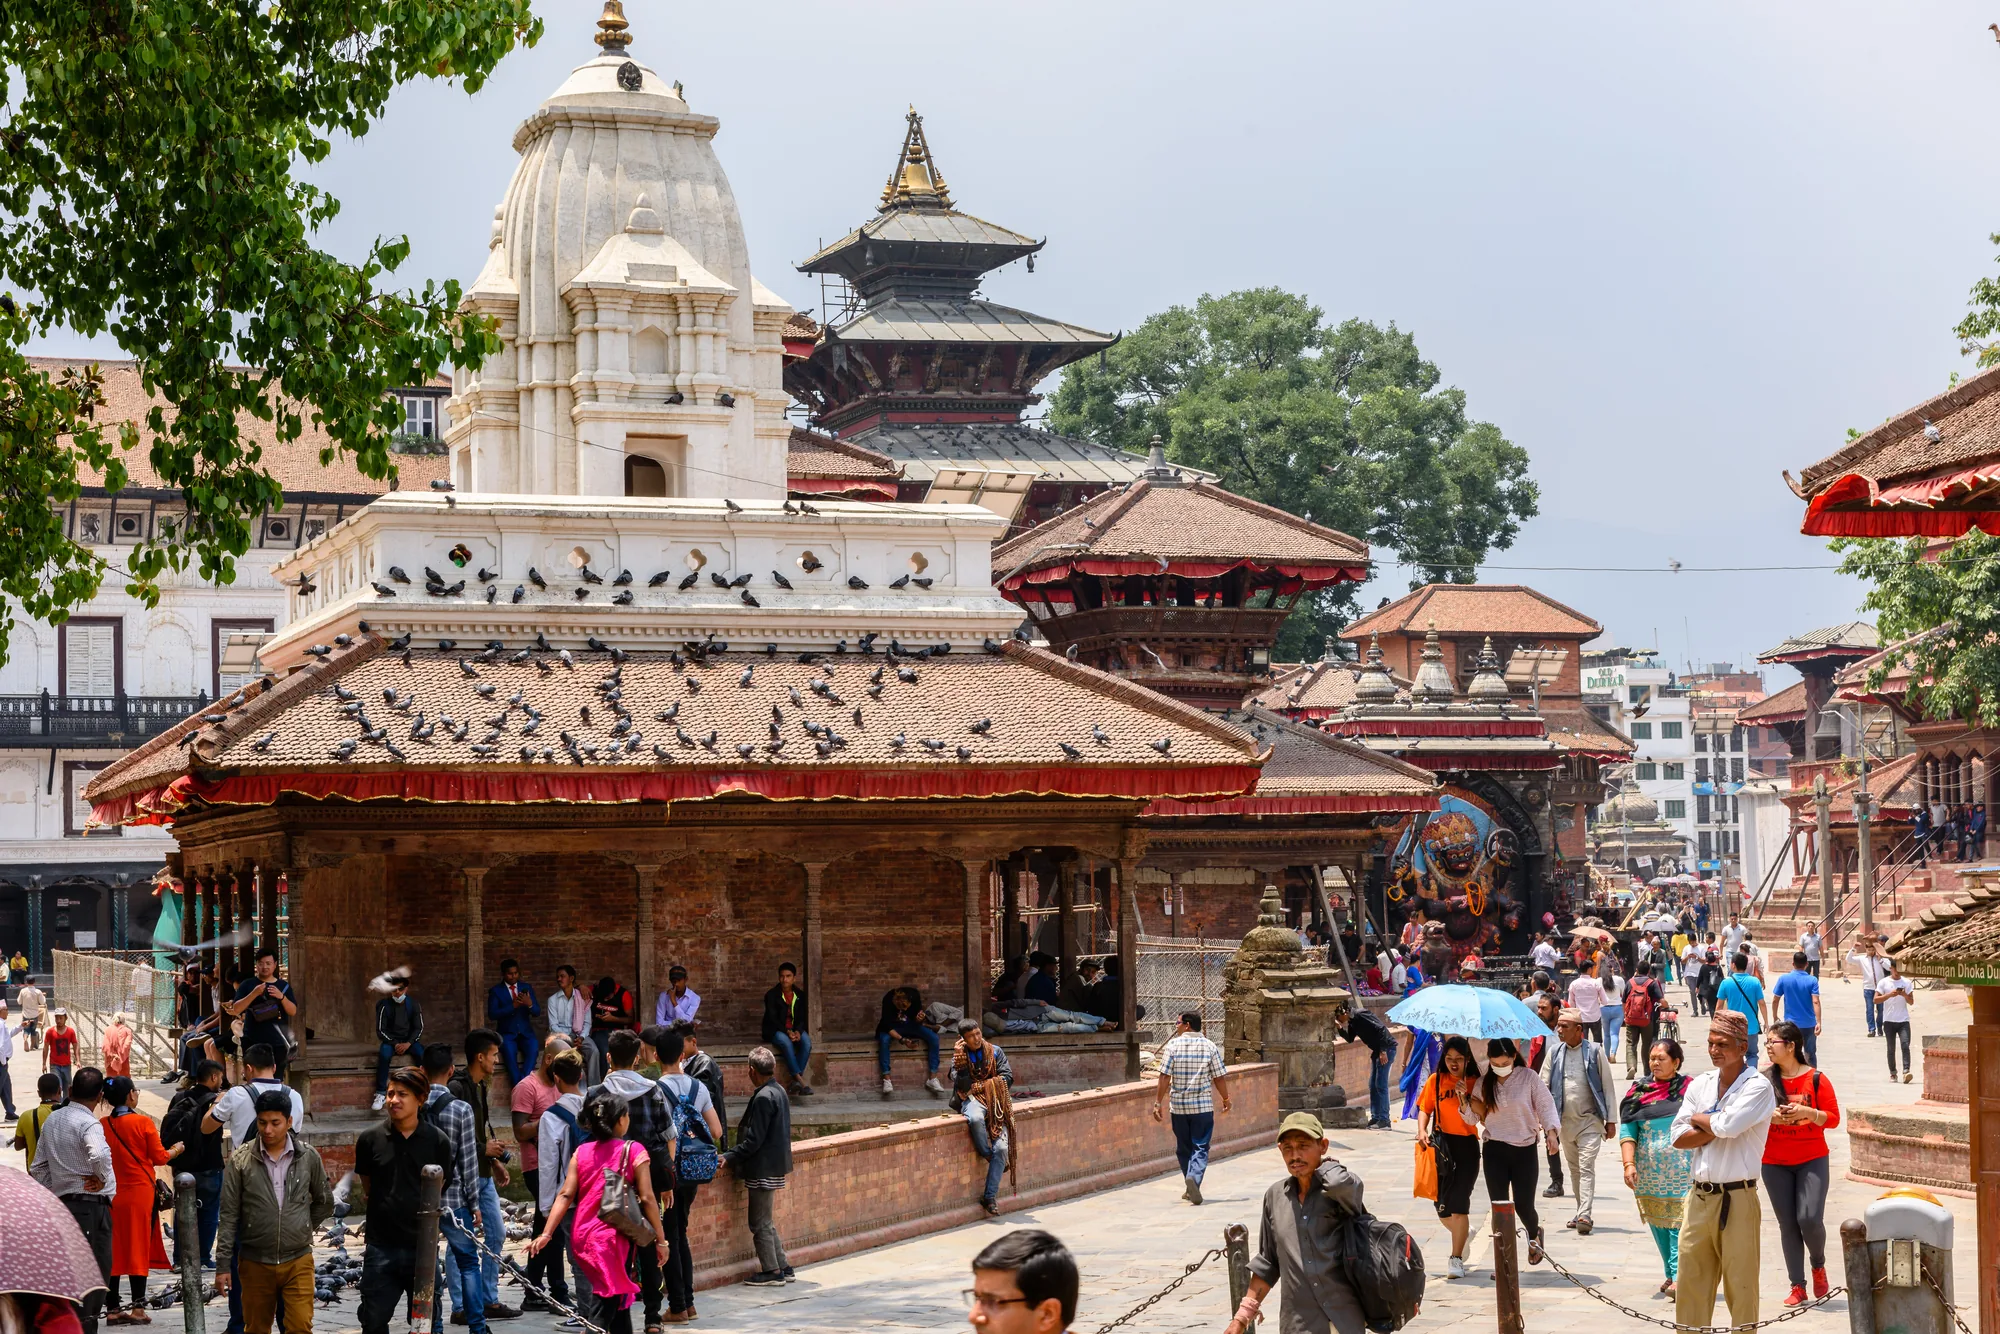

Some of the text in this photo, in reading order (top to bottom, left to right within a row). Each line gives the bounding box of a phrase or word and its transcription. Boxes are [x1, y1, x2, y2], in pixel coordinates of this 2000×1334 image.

[1598, 668, 1612, 677] OLD
[1587, 674, 1624, 688] DURBAR
[1915, 961, 2000, 980] Hanuman Dhoka Du
